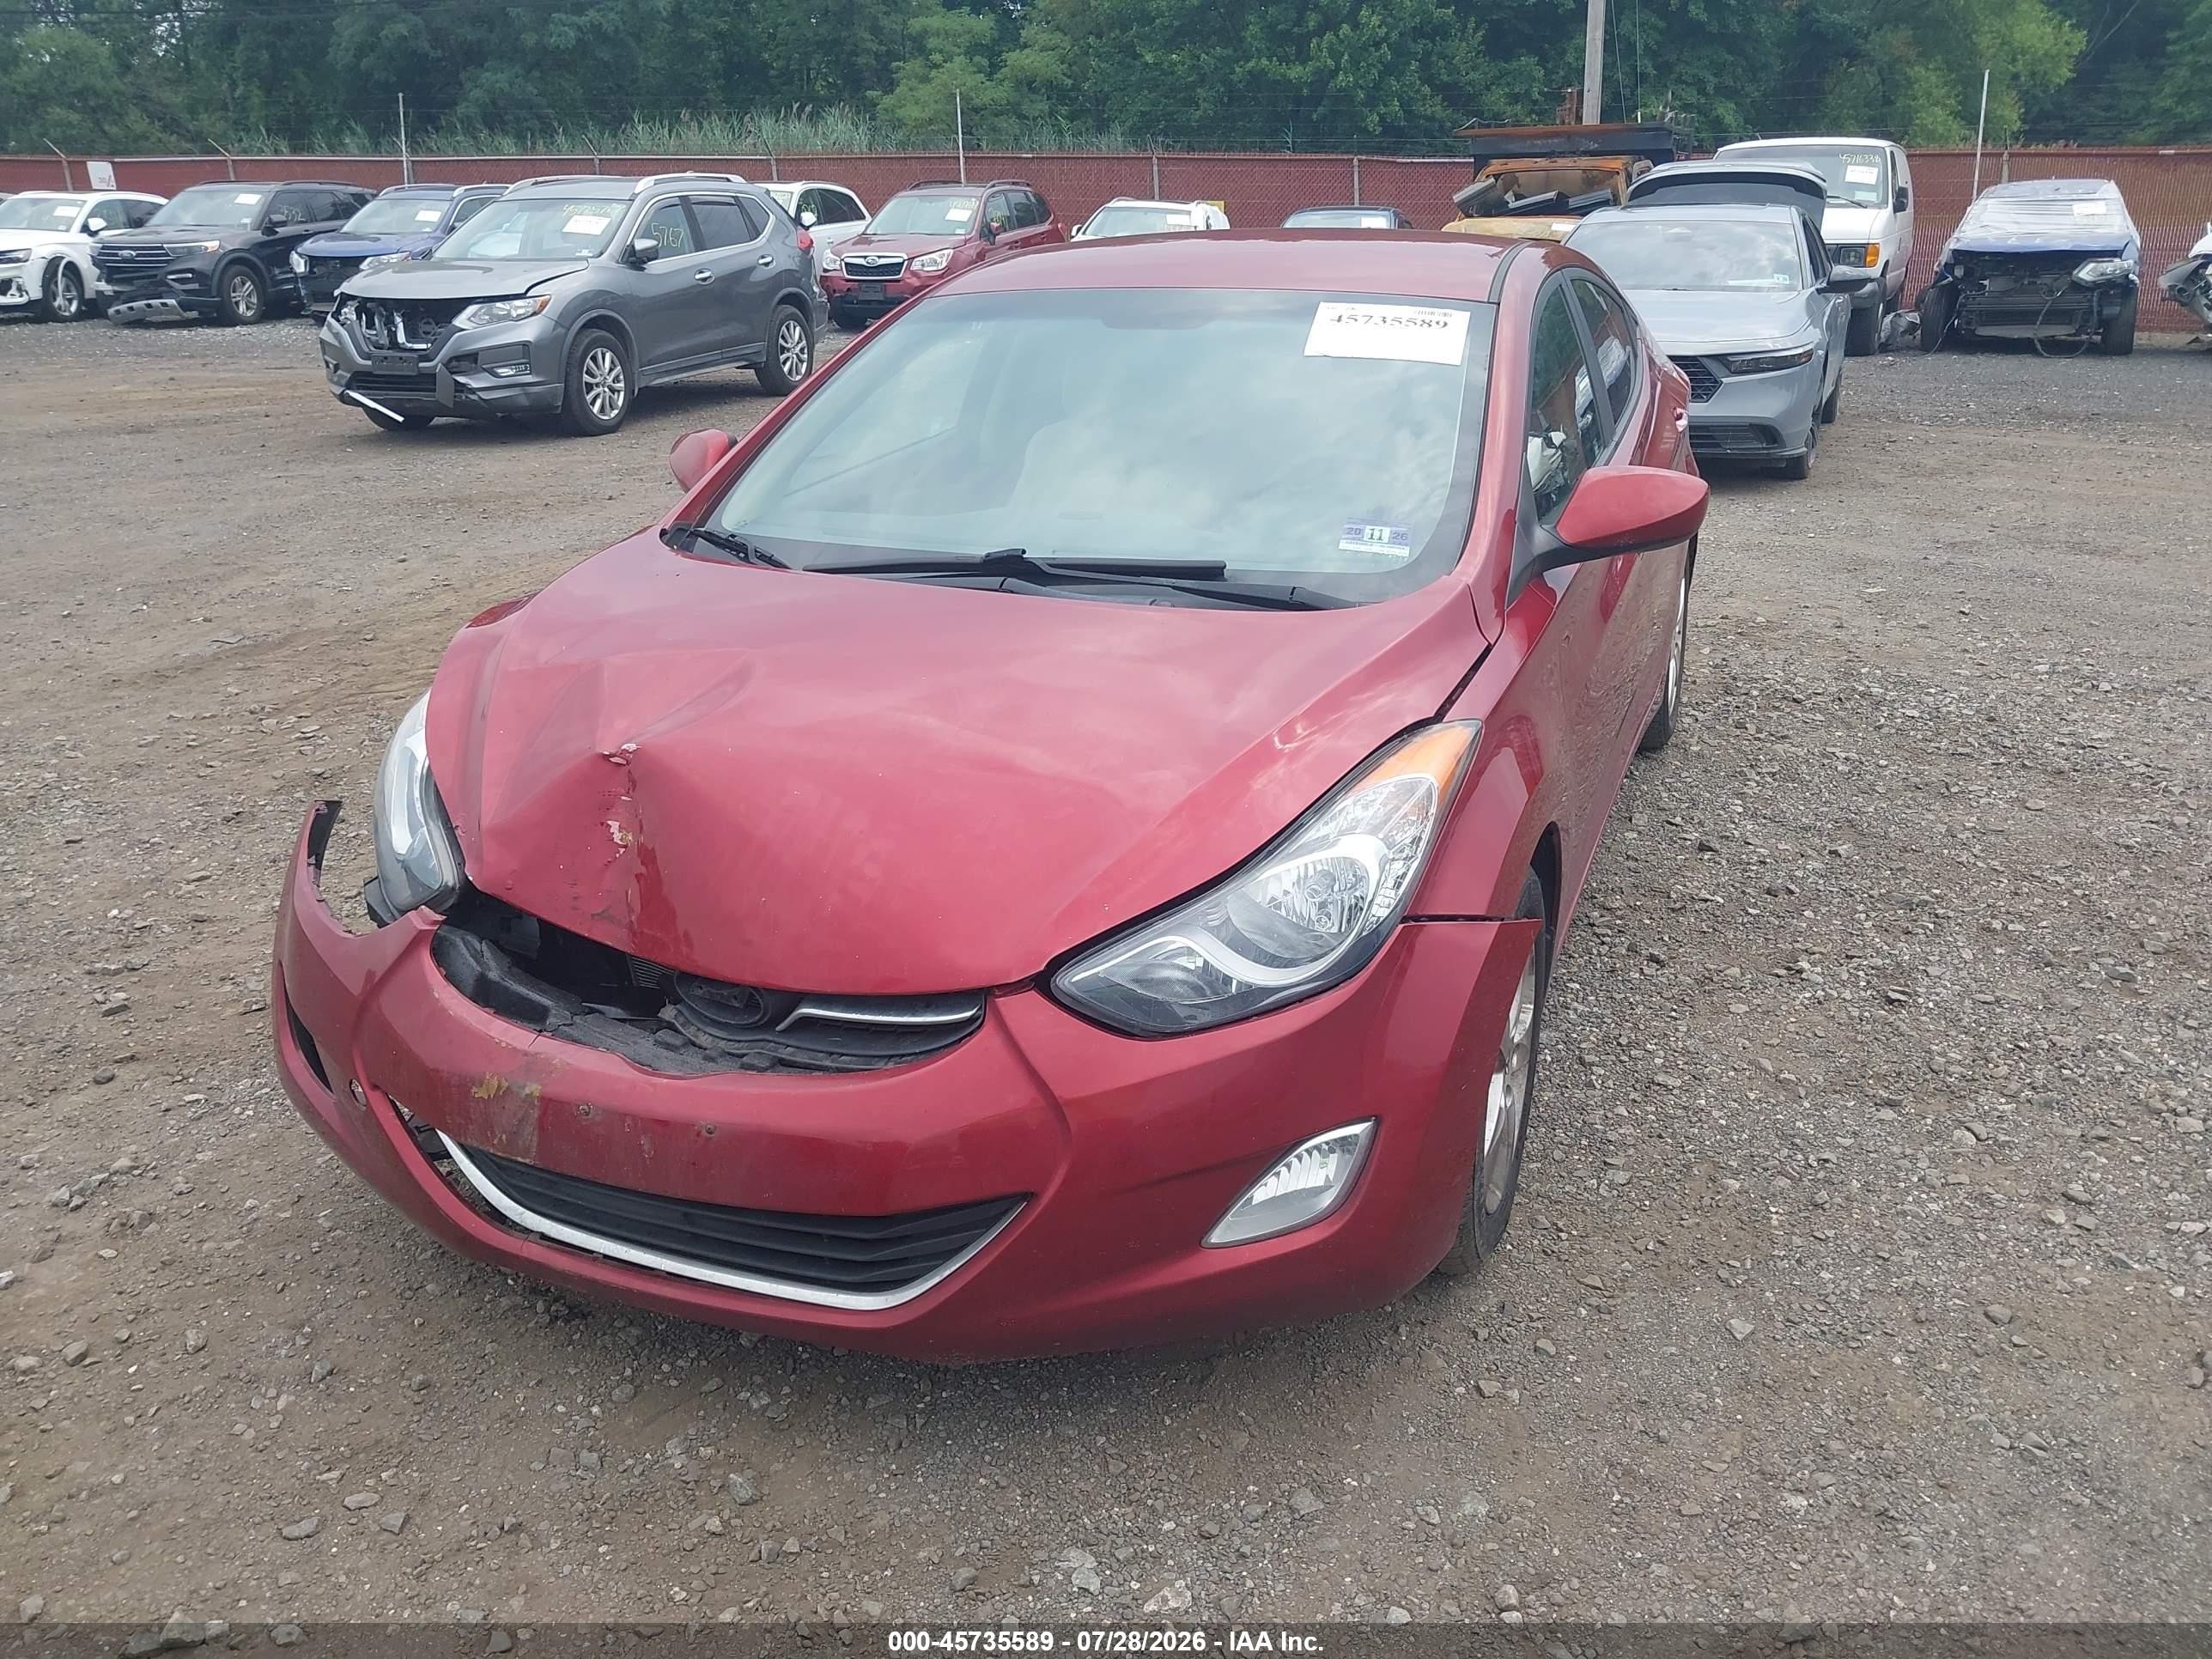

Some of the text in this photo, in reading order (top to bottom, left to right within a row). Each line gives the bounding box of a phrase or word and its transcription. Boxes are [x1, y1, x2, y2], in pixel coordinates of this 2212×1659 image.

[651, 222, 684, 248] 5767
[1329, 314, 1449, 329] 45735589
[1346, 527, 1408, 541] 20 11 26
